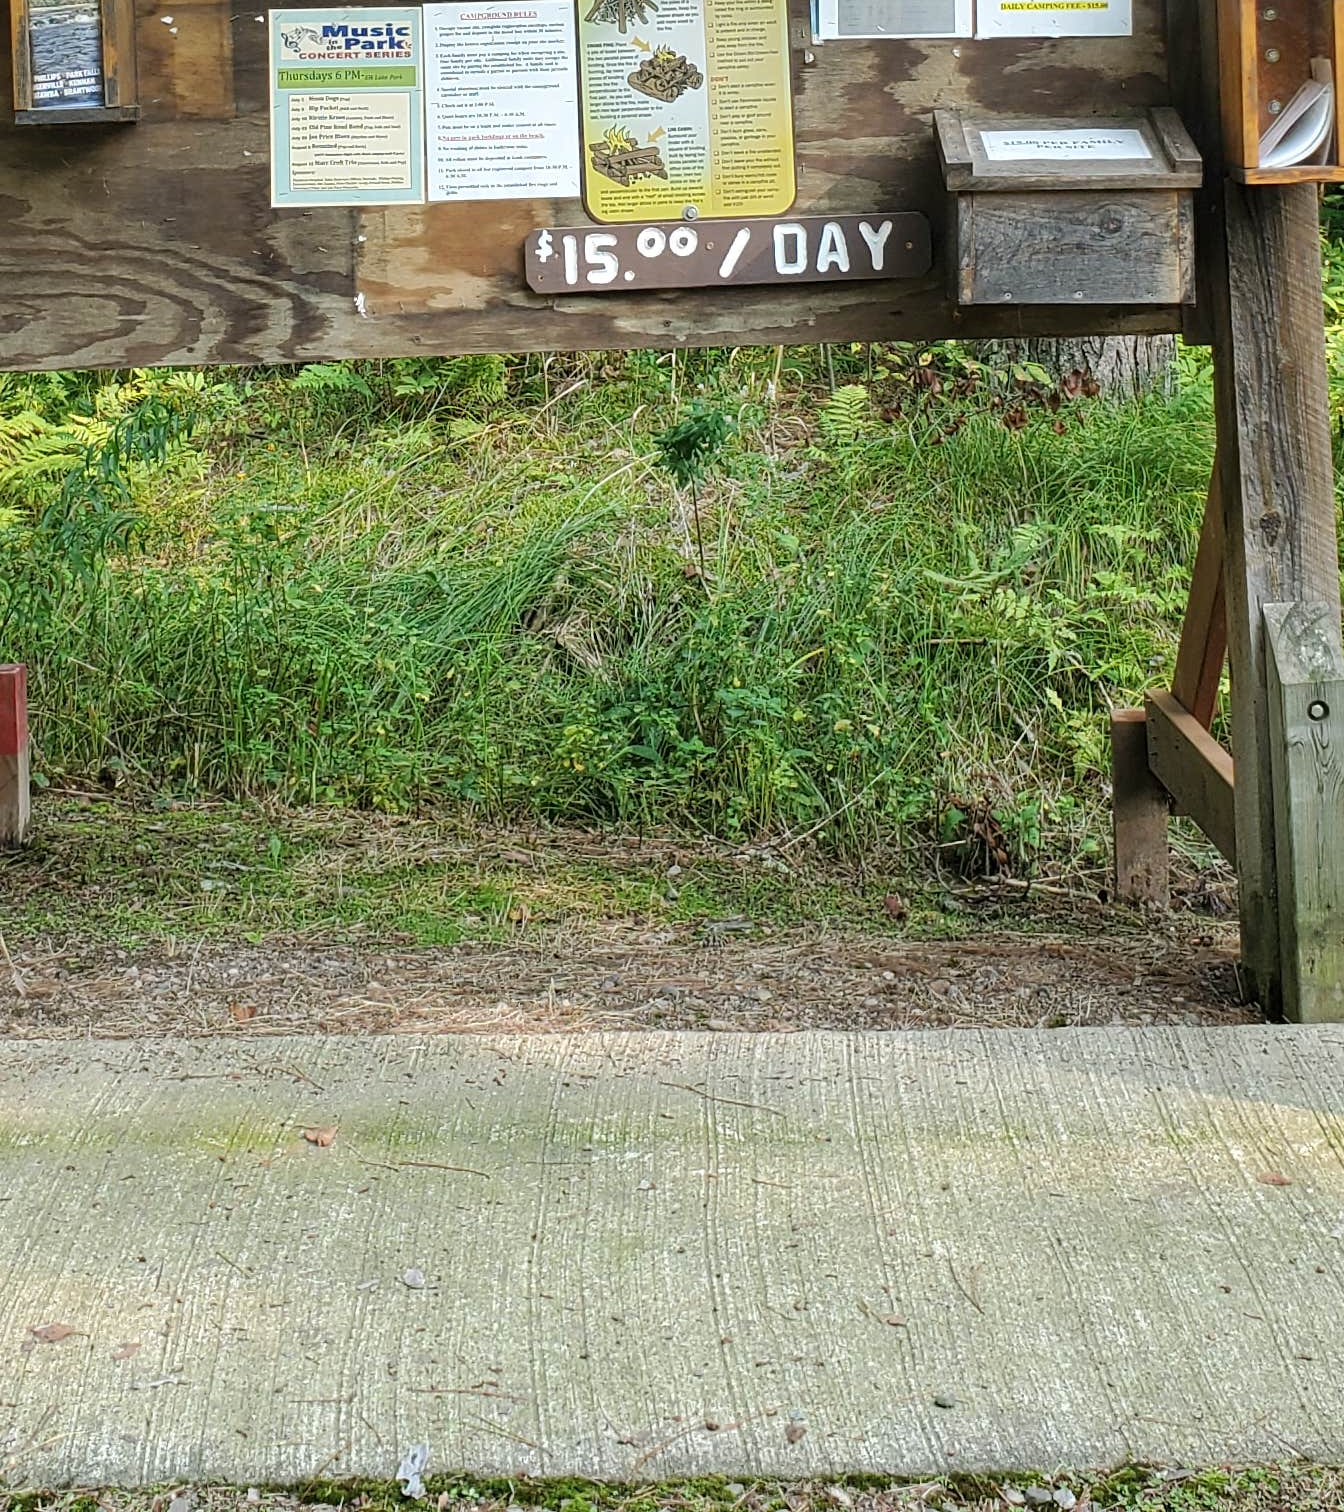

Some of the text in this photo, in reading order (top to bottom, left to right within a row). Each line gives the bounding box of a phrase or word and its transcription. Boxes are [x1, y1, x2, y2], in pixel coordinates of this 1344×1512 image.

[460, 11, 512, 20] CAMPGROUND
[322, 24, 409, 37] Music
[345, 38, 405, 50] Park
[279, 71, 333, 83] Thursdays
[335, 71, 341, 80] 6
[535, 221, 893, 285] $15.00 / DAY
